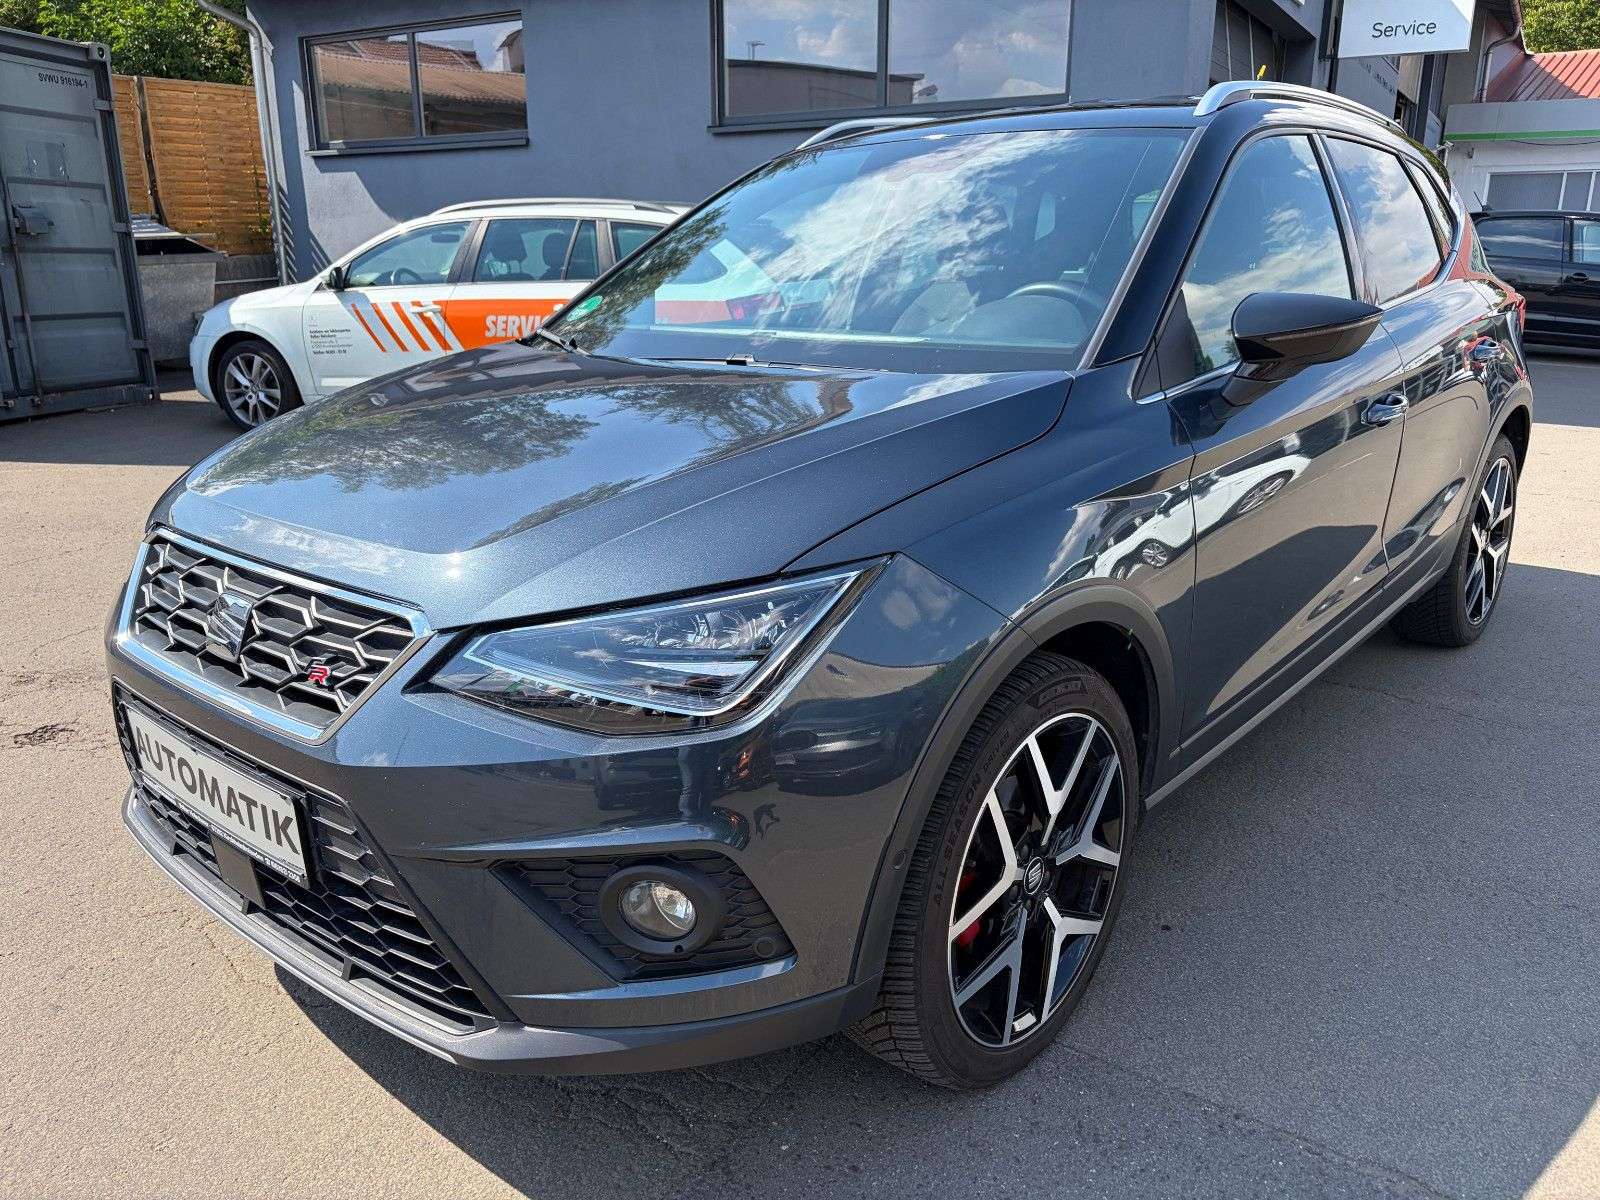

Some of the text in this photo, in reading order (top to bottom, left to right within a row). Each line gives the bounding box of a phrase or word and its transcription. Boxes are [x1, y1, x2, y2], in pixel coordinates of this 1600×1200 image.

[1371, 19, 1437, 38] Service
[484, 315, 550, 338] SERVI
[136, 725, 300, 855] AUTOMATIK
